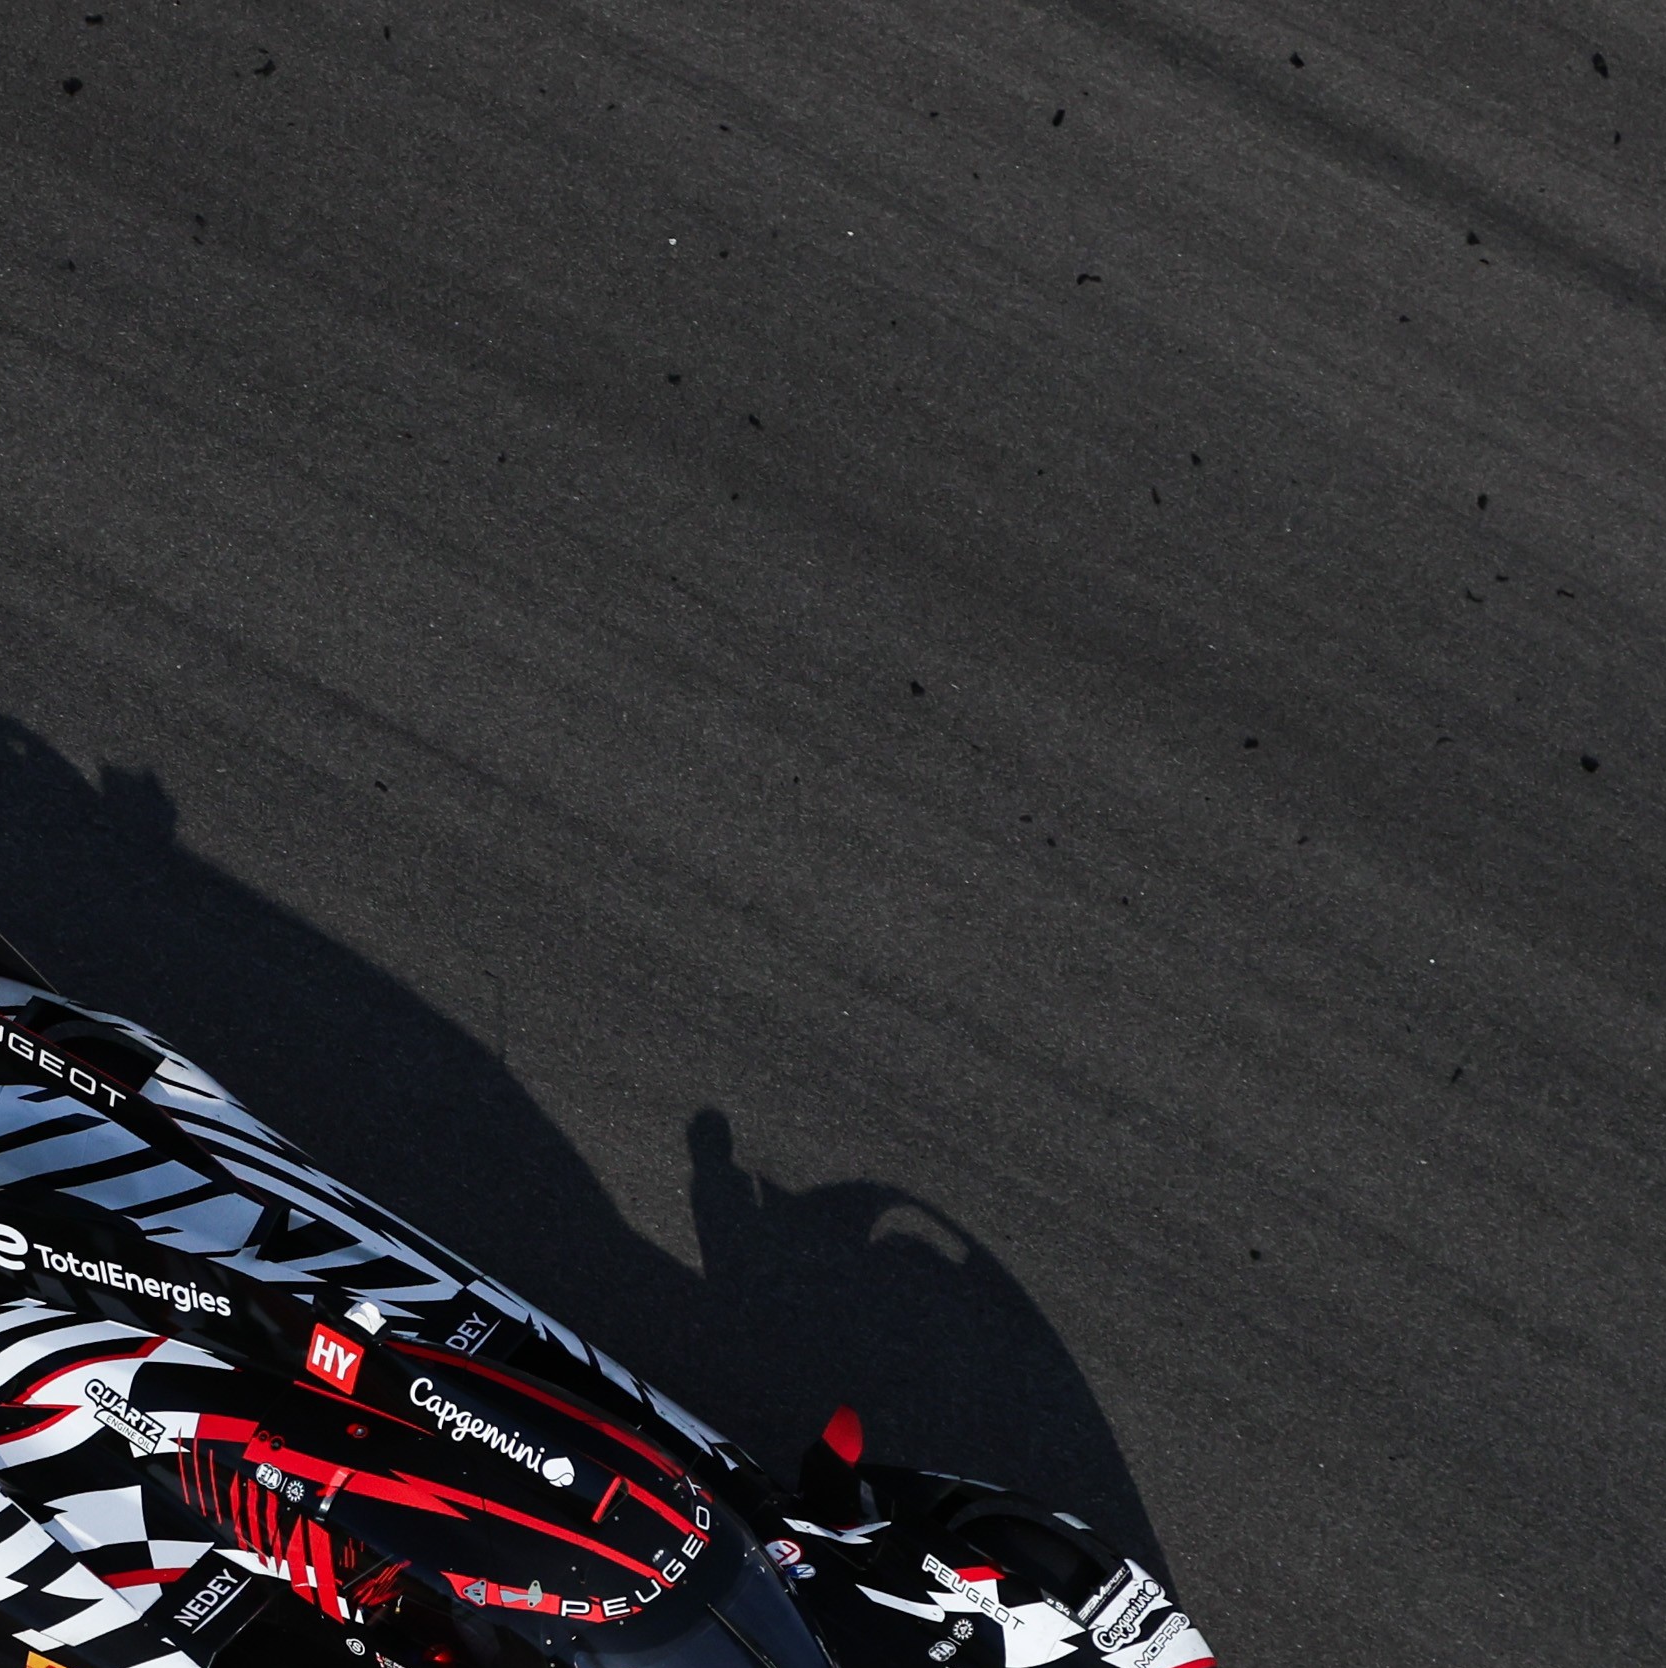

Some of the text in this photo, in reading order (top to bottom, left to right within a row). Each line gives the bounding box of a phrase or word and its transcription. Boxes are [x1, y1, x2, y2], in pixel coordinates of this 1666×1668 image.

[33, 1243, 232, 1317] TotalEnergies
[310, 1334, 357, 1381] HY
[445, 1312, 489, 1350] DEY
[85, 1379, 166, 1443] QUARTZ
[106, 1415, 151, 1450] ENGINE OIL
[409, 1377, 546, 1474] Capgemini
[561, 1475, 710, 1617] PEUGEOT
[173, 1568, 239, 1628] NEDEY
[923, 1556, 1025, 1631] PEUGEOT
[1098, 1587, 1154, 1648] Capgemini
